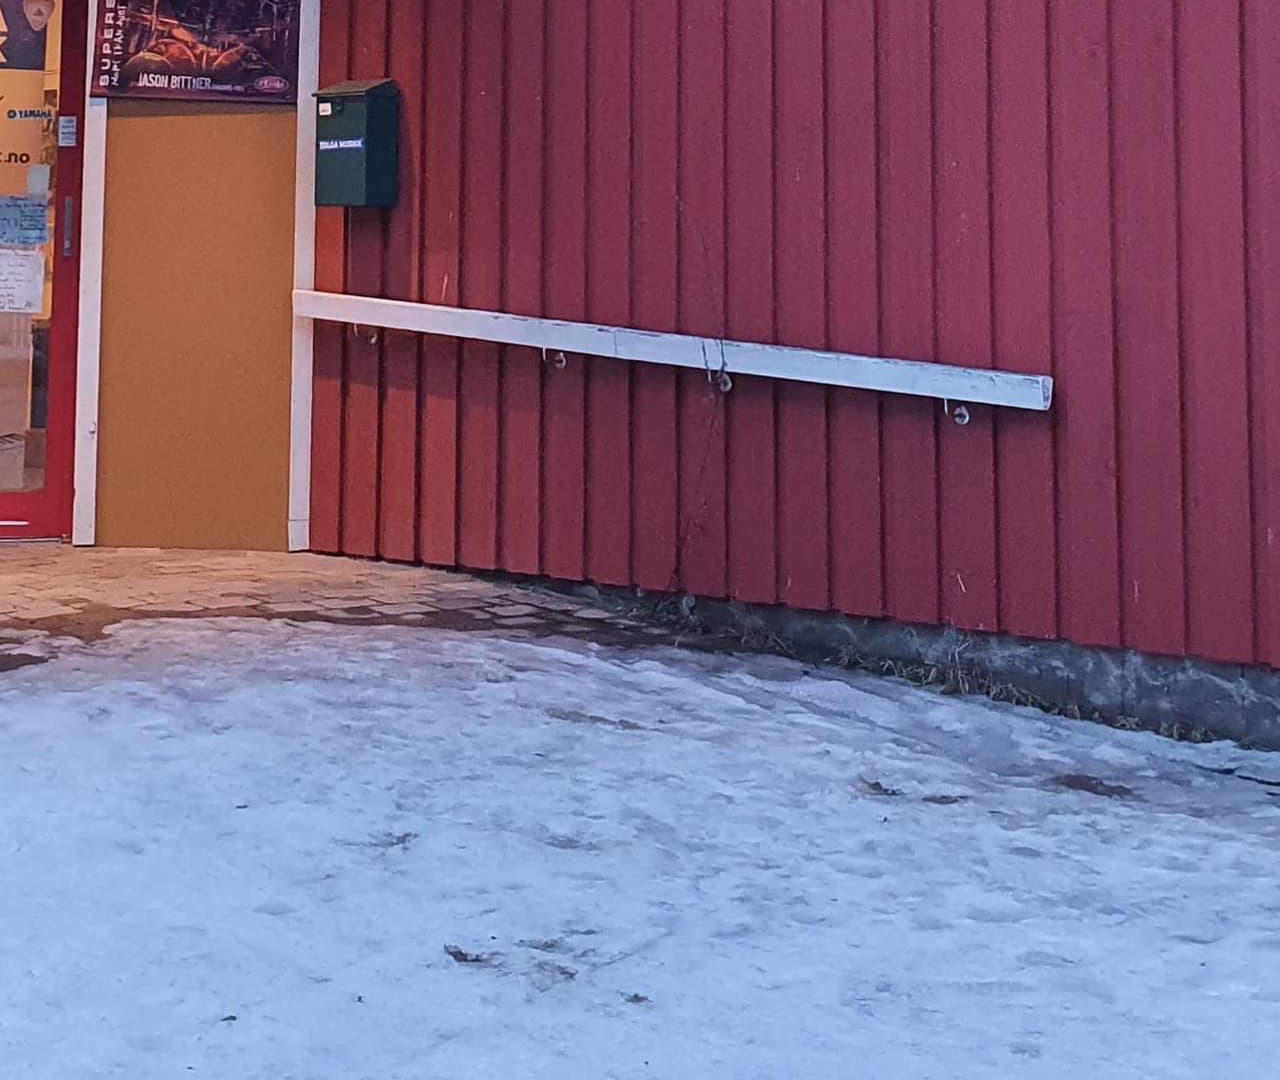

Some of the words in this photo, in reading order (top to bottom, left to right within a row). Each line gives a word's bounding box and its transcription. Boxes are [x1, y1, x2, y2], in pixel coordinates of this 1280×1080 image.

[138, 72, 168, 88] JASON
[171, 75, 212, 90] BITTNER
[19, 109, 52, 119] YAMAHA
